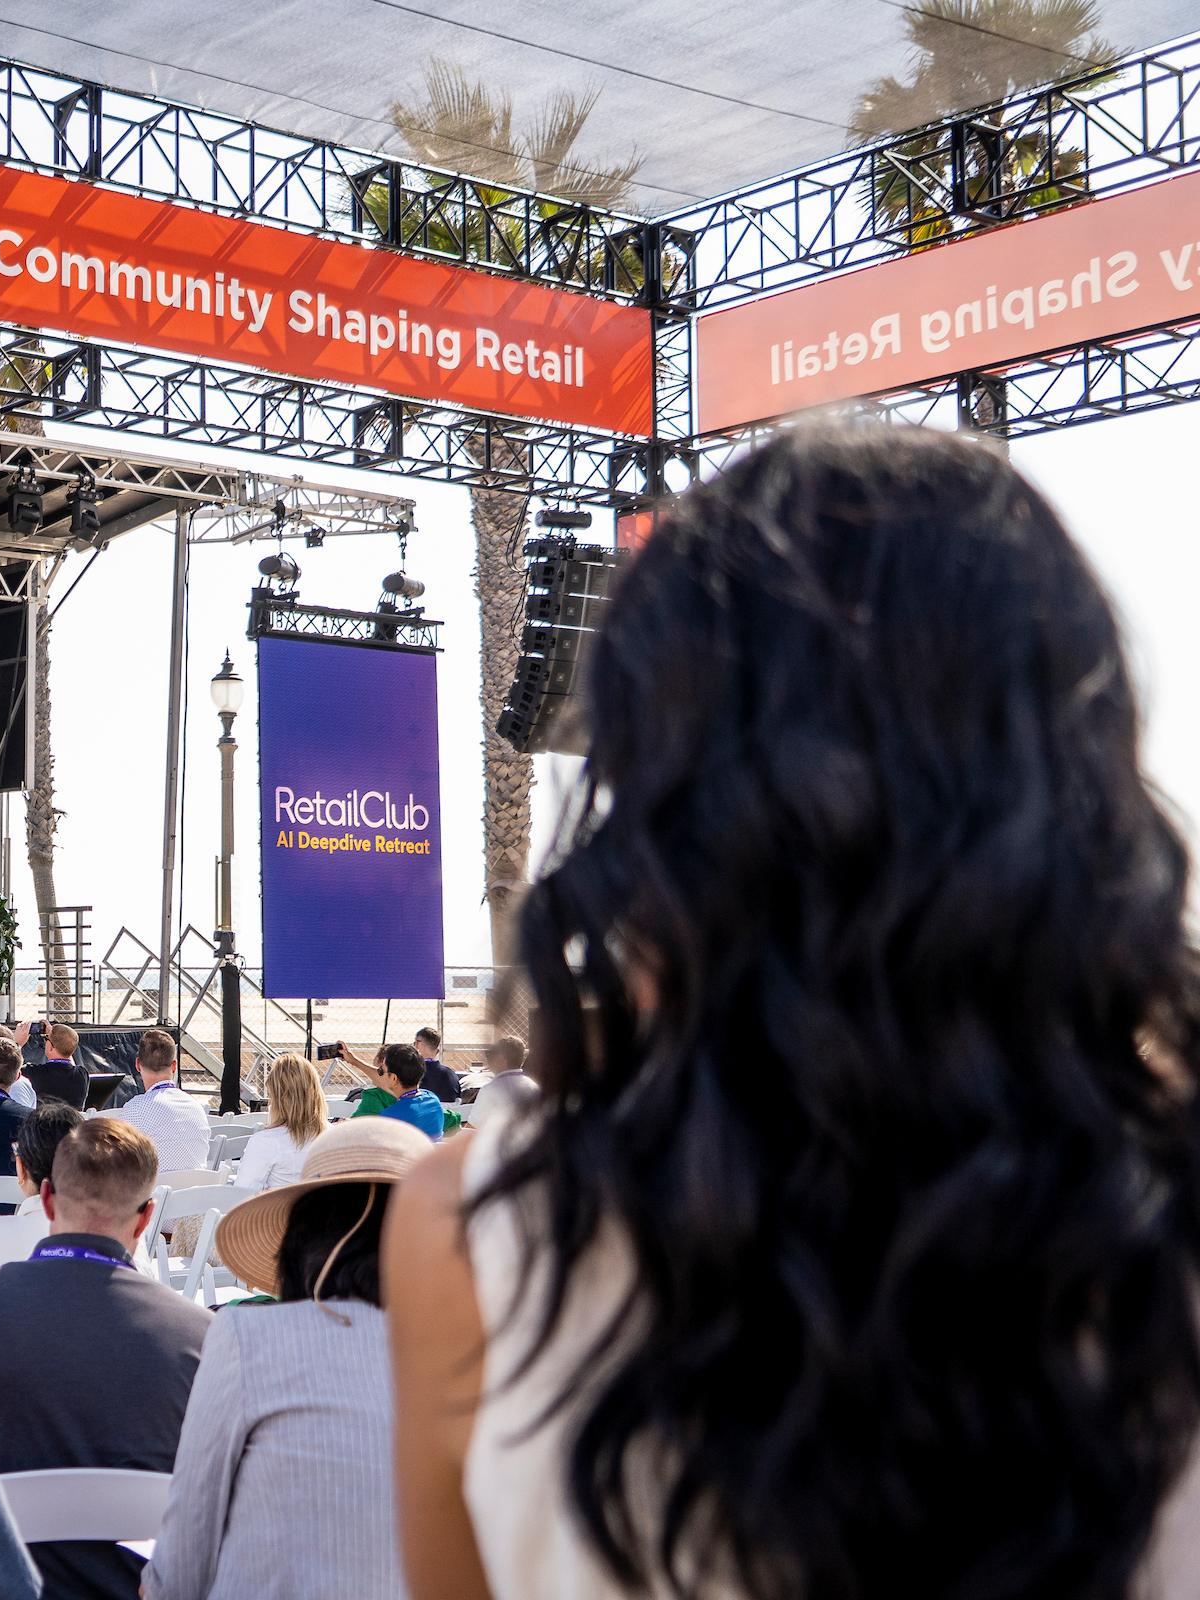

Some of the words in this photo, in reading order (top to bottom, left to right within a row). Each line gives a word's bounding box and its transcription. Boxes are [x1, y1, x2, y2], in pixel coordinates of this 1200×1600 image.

[287, 290, 462, 371] Shaping
[475, 325, 586, 388] Retail
[275, 786, 430, 831] RetailClub
[276, 831, 293, 848] AI
[298, 831, 371, 854] Deepdive
[375, 835, 431, 854] Retreat
